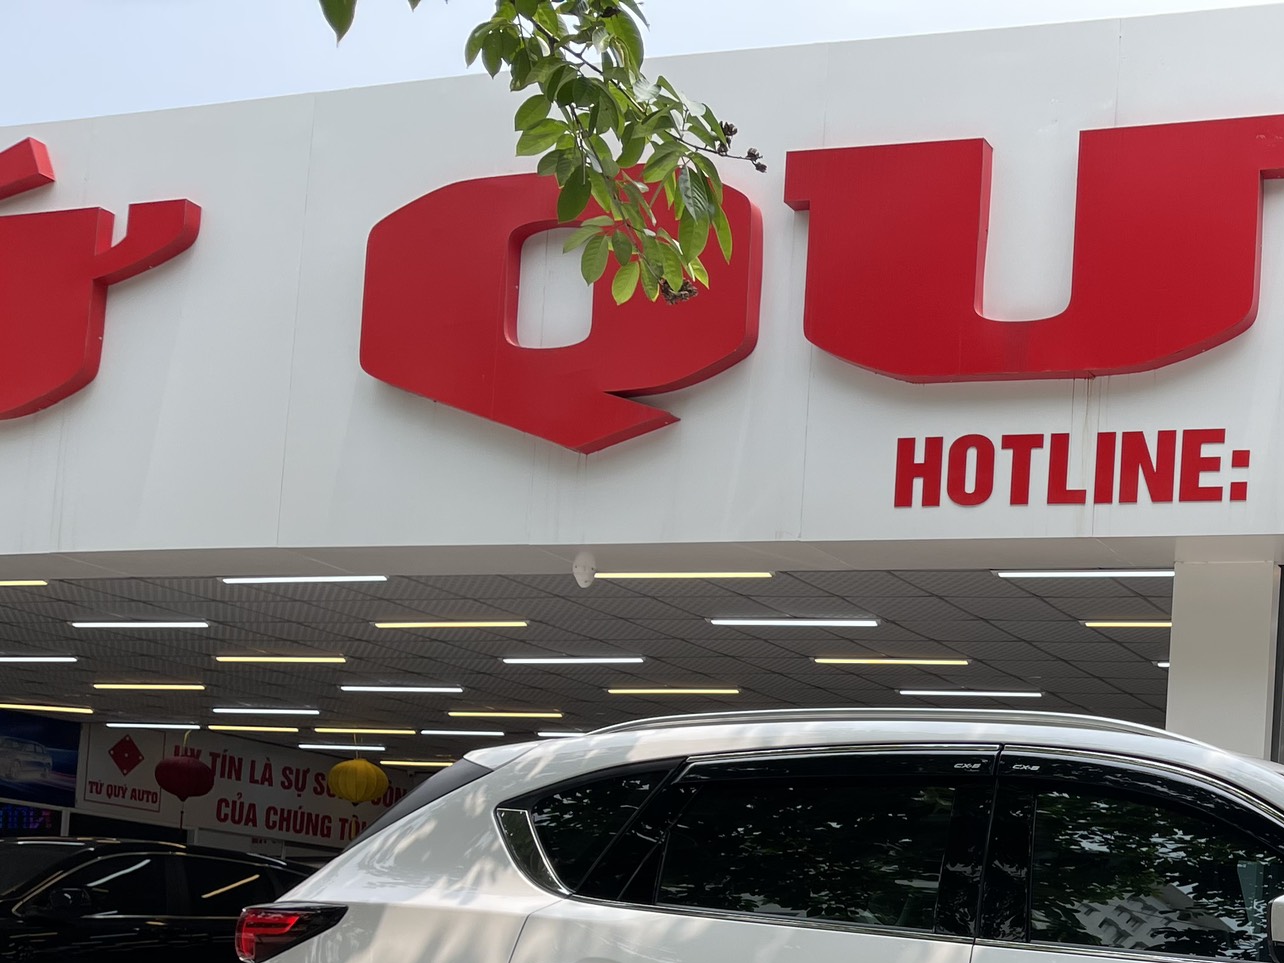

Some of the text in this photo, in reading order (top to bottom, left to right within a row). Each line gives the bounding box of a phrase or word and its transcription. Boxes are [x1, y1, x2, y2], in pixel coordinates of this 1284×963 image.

[894, 428, 1250, 508] HOTLINE:
[130, 788, 158, 804] AUTO
[249, 756, 274, 787] LÀ
[280, 766, 311, 798] SỰ
[216, 792, 258, 828] CỦA
[264, 805, 332, 841] CHÚNG
